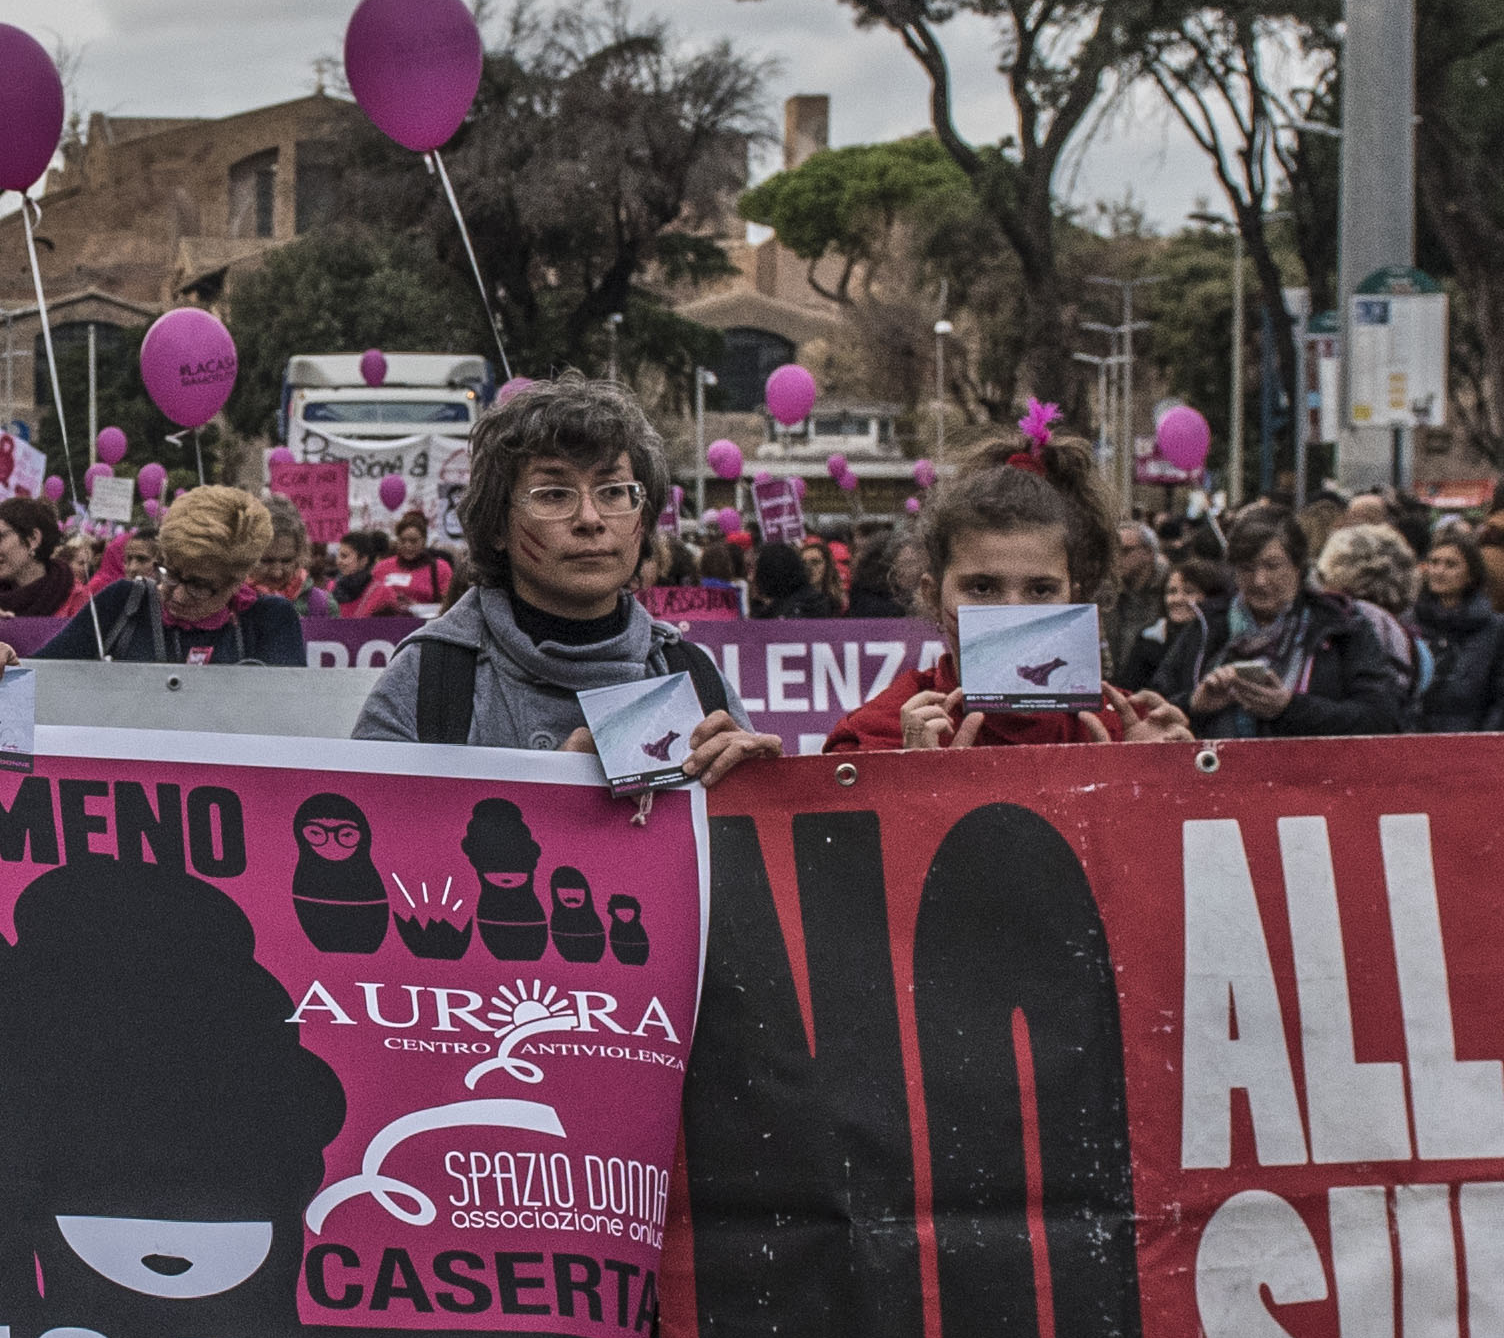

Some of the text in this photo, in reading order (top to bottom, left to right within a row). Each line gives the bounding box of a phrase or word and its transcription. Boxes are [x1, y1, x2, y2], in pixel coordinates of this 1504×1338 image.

[383, 1036, 685, 1072] CENTRO ANTIVIOLENZA
[444, 1150, 670, 1228] SPAZIO DONNA
[450, 1207, 625, 1238] associazione
[305, 1243, 657, 1334] CASERTA
